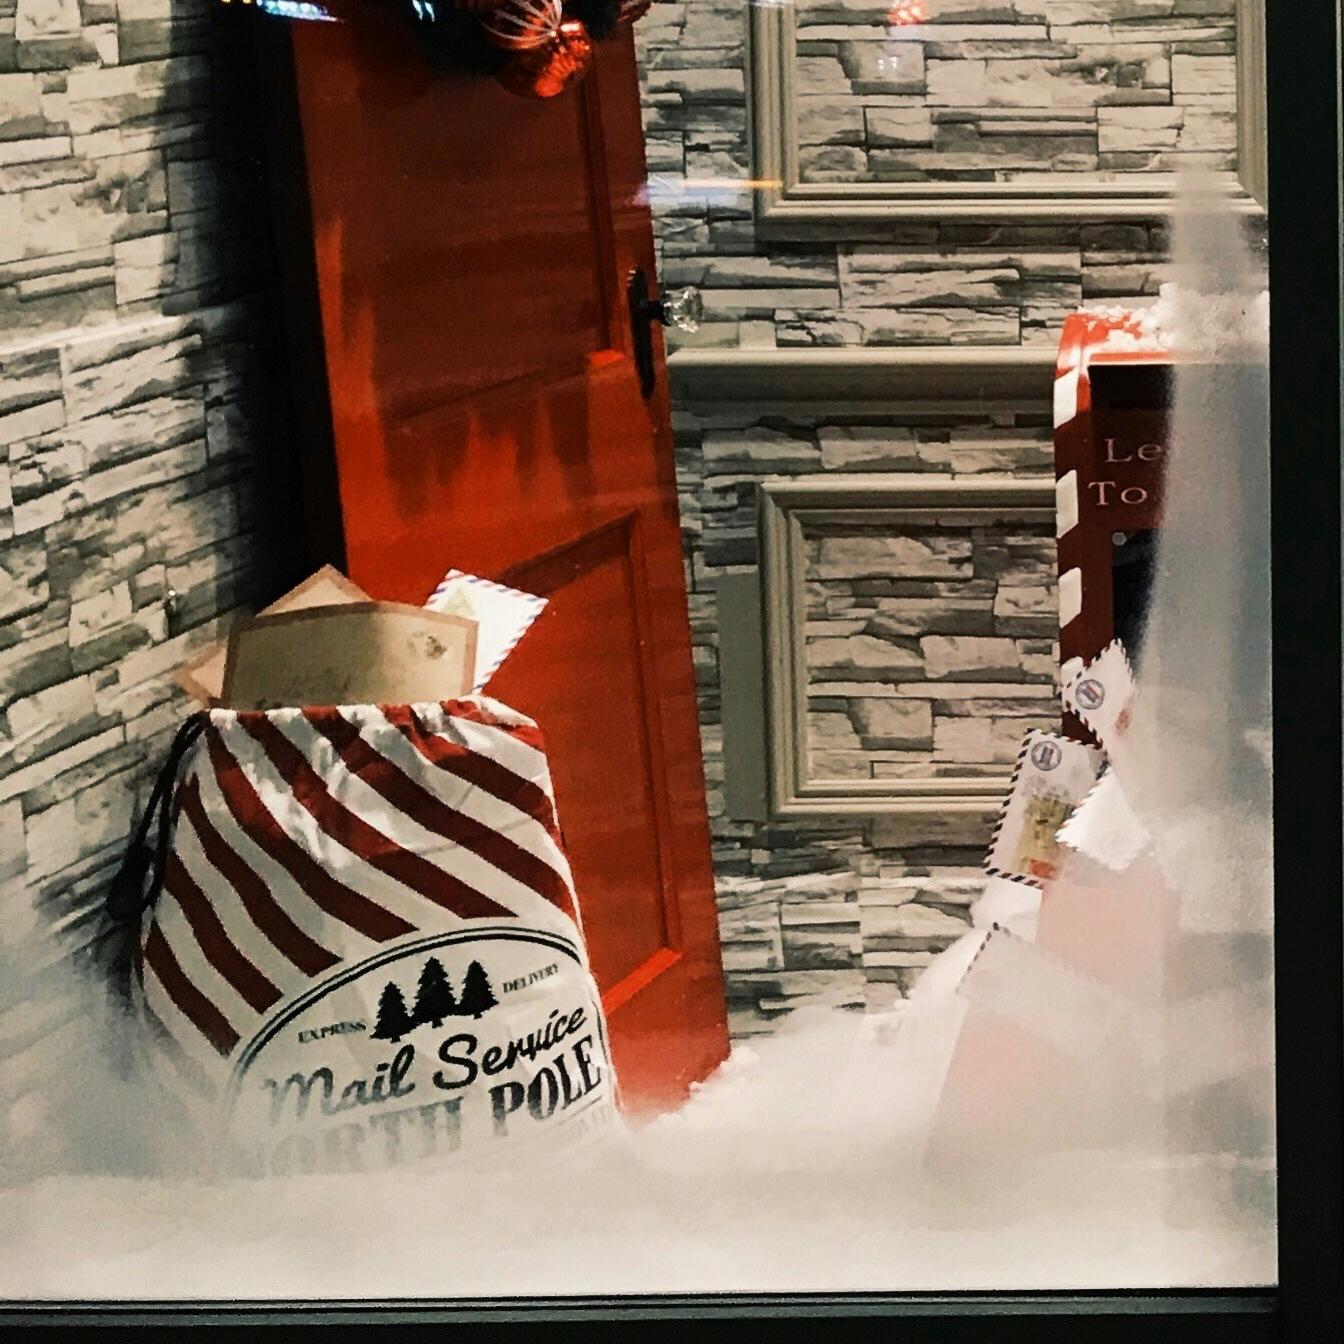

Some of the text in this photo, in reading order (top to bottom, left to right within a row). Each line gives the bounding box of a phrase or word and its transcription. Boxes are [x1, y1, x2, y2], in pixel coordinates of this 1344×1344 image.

[1087, 481, 1148, 506] To
[260, 1007, 588, 1128] Mail Service
[297, 1020, 368, 1044] EXPRESS
[255, 1035, 604, 1175] ORTH POLE
